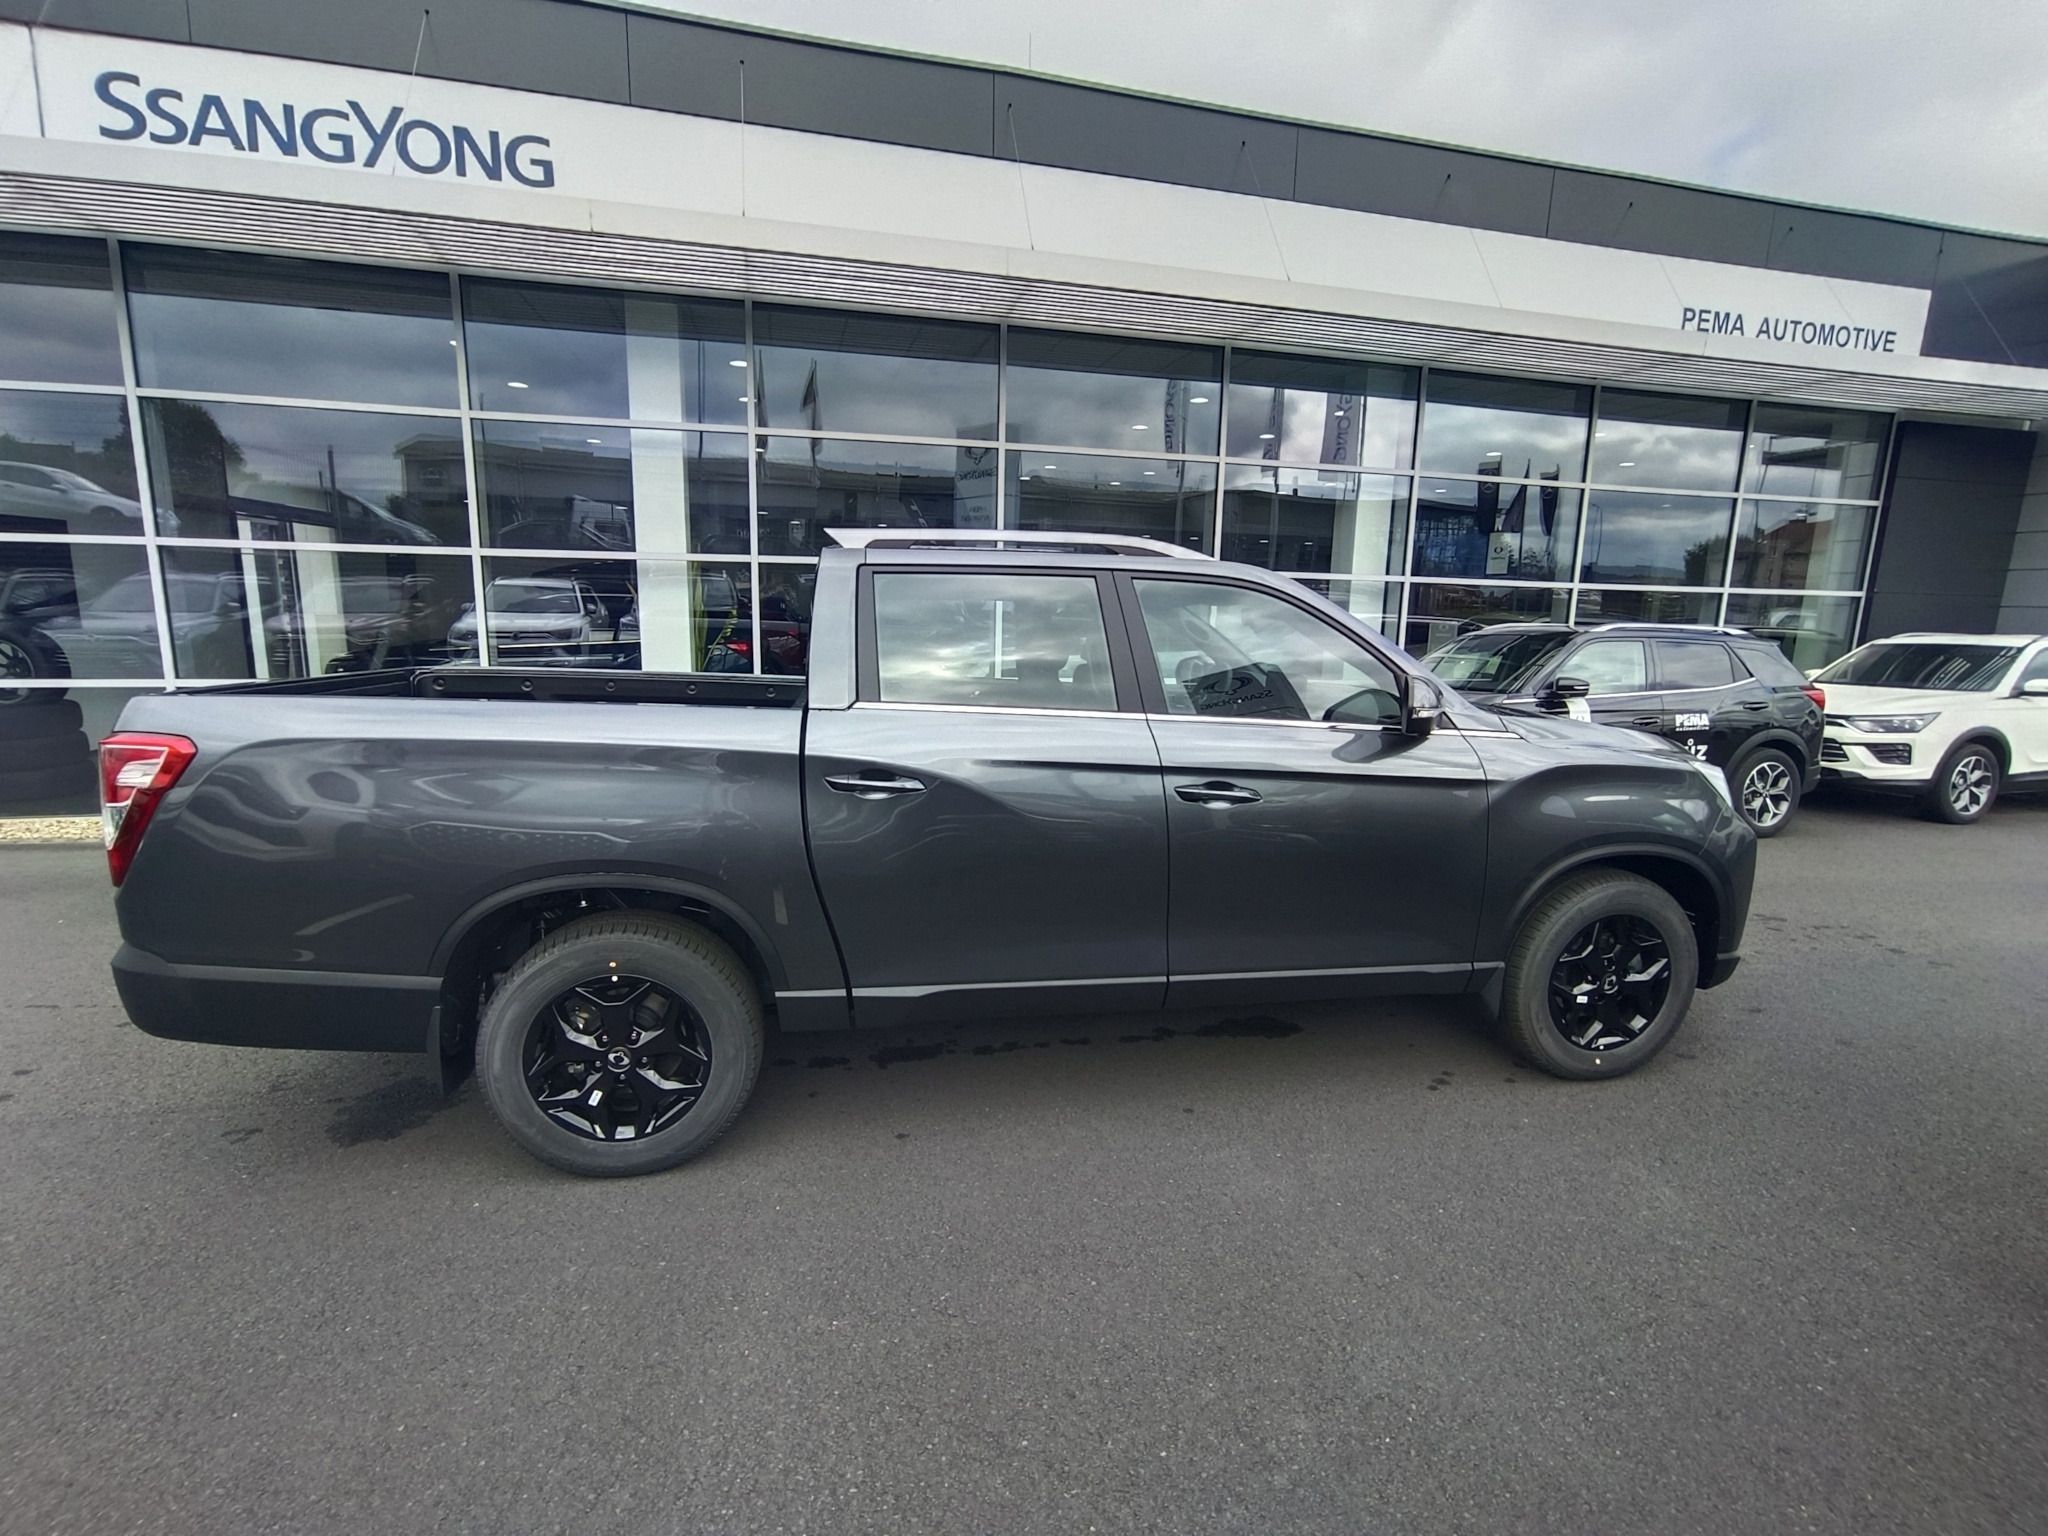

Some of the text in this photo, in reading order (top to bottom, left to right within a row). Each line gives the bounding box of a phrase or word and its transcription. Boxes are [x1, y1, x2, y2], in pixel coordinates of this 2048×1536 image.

[94, 70, 556, 189] SSANGYONG
[1681, 307, 1897, 352] PEMA AUTOMOTIVE
[1675, 713, 1710, 727] PEMA
